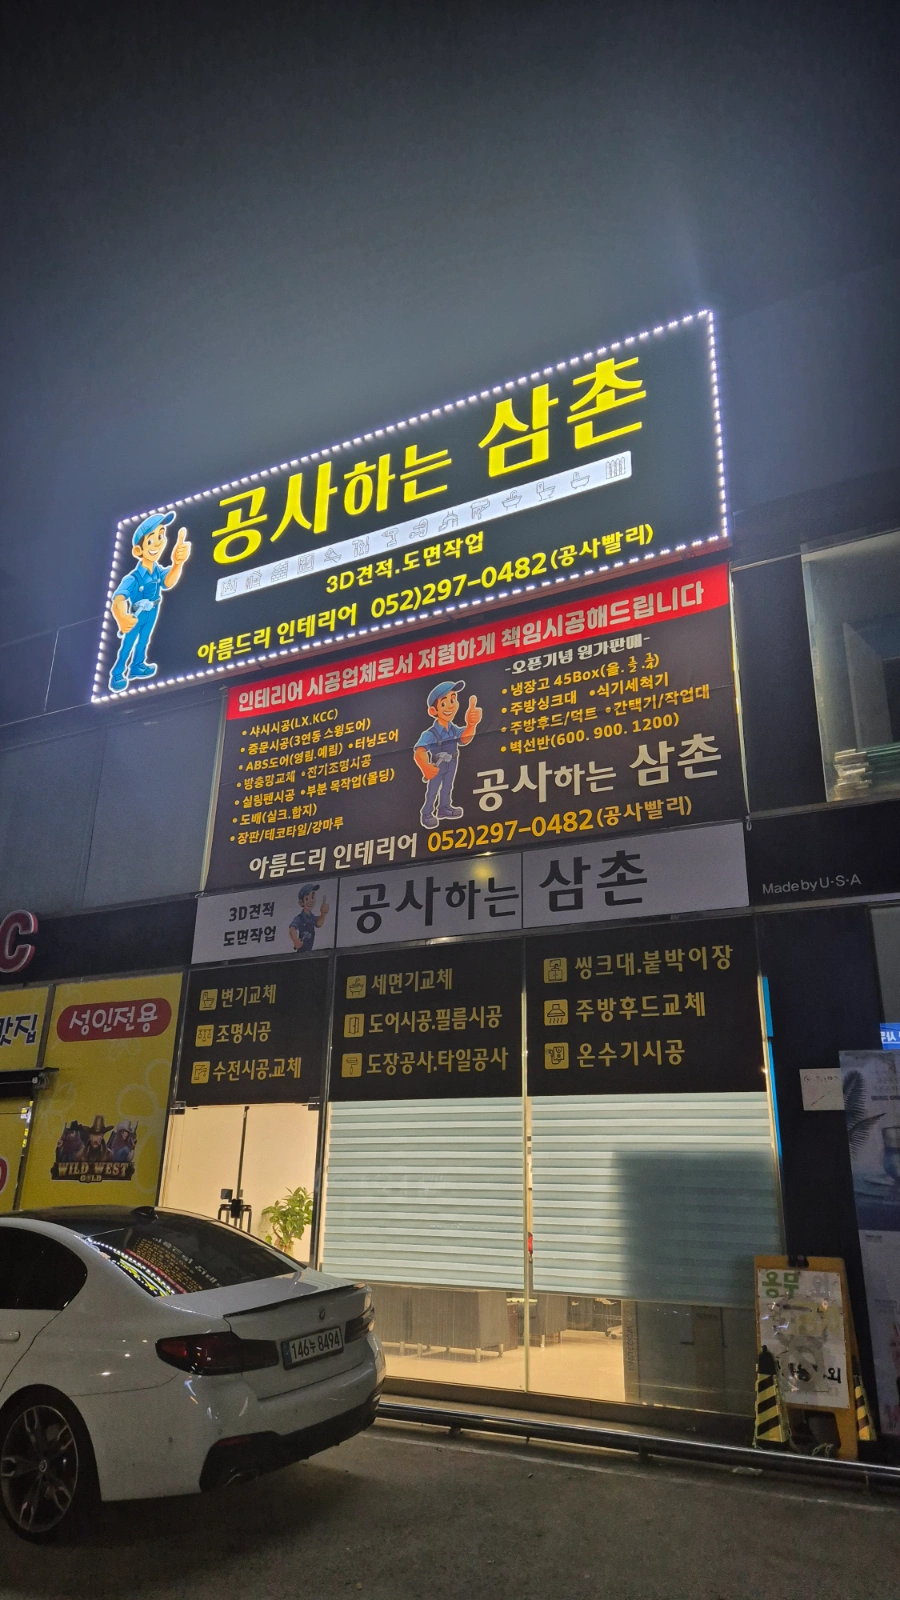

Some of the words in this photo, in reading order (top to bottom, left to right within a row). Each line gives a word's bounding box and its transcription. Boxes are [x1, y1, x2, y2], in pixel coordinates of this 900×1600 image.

[210, 444, 452, 565] 공사하는
[478, 356, 646, 477] 삼촌
[197, 627, 271, 664] 아름드리
[277, 603, 357, 644] 인테리어
[238, 680, 303, 712] 인테리어
[307, 653, 413, 698] 시공업체로서
[418, 632, 495, 670] 저렴하게
[501, 581, 705, 648] 책임시공해드립니다
[510, 677, 550, 697] 냉장고
[510, 690, 577, 715] 주방싱크대
[596, 671, 669, 697] 식기세척기
[249, 708, 338, 738] 샤시시공(LX.KCC)
[509, 706, 599, 735] 주방후드/덕트
[614, 684, 710, 716] 간택기/작업대
[632, 712, 680, 733] 1200)
[323, 718, 371, 739] 스윙도어)
[355, 729, 399, 750] 터닝도어
[243, 770, 296, 790] 방충망교체
[307, 753, 371, 779] 전기조명시공
[306, 782, 328, 798] 부분
[330, 768, 395, 793] 목작업(몰딩)
[472, 761, 617, 813] 공사하는
[629, 733, 721, 787] 삼촌
[249, 847, 327, 880] 아름드리
[333, 832, 418, 869] 인테리어
[350, 876, 520, 934] 공사하는
[539, 850, 647, 912] 삼촌
[762, 881, 800, 895] Made
[800, 879, 818, 892] by
[229, 901, 275, 922] 3D견적
[223, 925, 277, 947] 도면작업
[221, 984, 277, 1008] 변기교체
[371, 968, 454, 996] 세면기교체
[69, 1002, 158, 1037] 성인전용
[369, 1005, 503, 1034] 도어시공.필름시공
[575, 991, 706, 1023] 주방후드교체
[216, 1021, 271, 1045] 조명시공
[366, 1046, 509, 1076] 도장공사.타일공사
[576, 1039, 685, 1068] 온수기시공
[212, 1057, 302, 1082] 수전시공.교체
[57, 1161, 90, 1177] WILD
[94, 1161, 129, 1177] WEST
[291, 1339, 316, 1359] 146누
[317, 1331, 340, 1351] 8494
